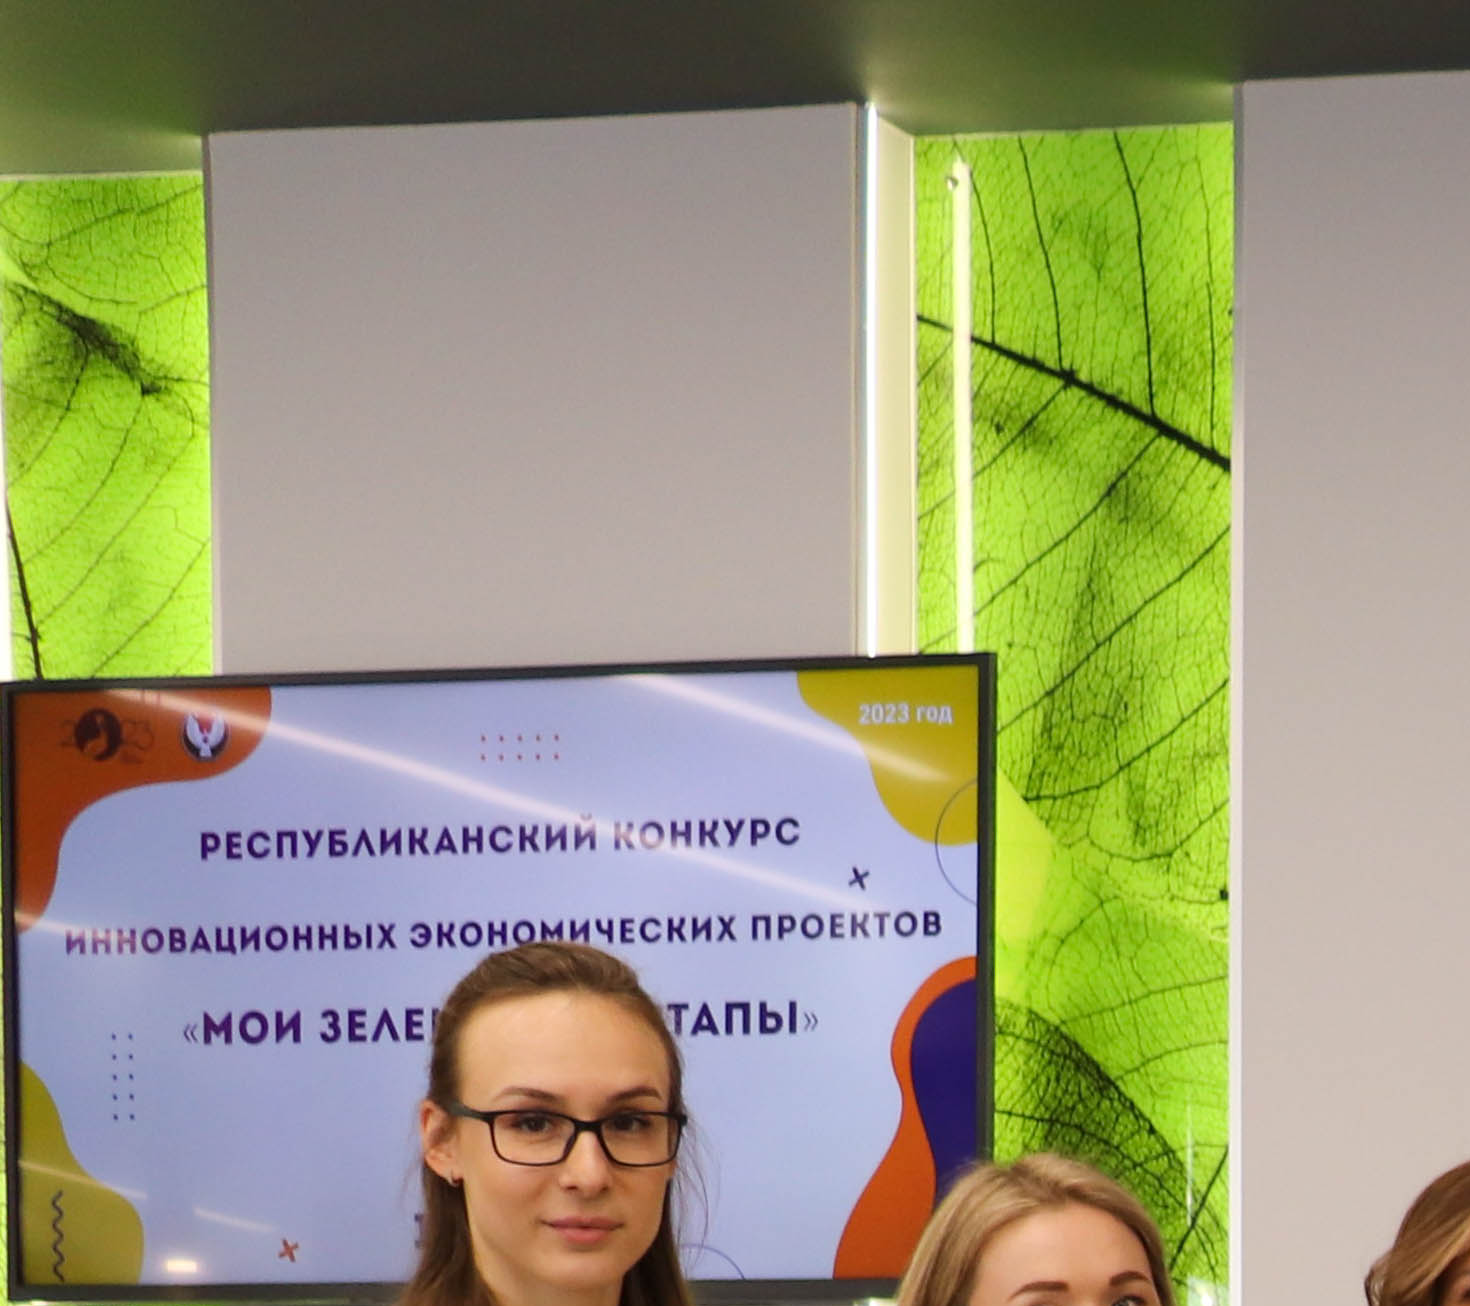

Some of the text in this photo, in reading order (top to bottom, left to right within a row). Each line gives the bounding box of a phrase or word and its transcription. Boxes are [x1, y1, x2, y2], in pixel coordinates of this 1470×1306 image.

[858, 702, 954, 727] 2023 год
[199, 815, 801, 862] РЕСПУБЛИКАНСКИЙ КОНКУРС
[65, 909, 943, 956] ИННОВАЦИОННЫХ ЭКОНОМИЧЕСКИХ ПРОЕКТОВ
[183, 1000, 820, 1046] «МОИ ЗЕЛЕ ТАПЫ»
